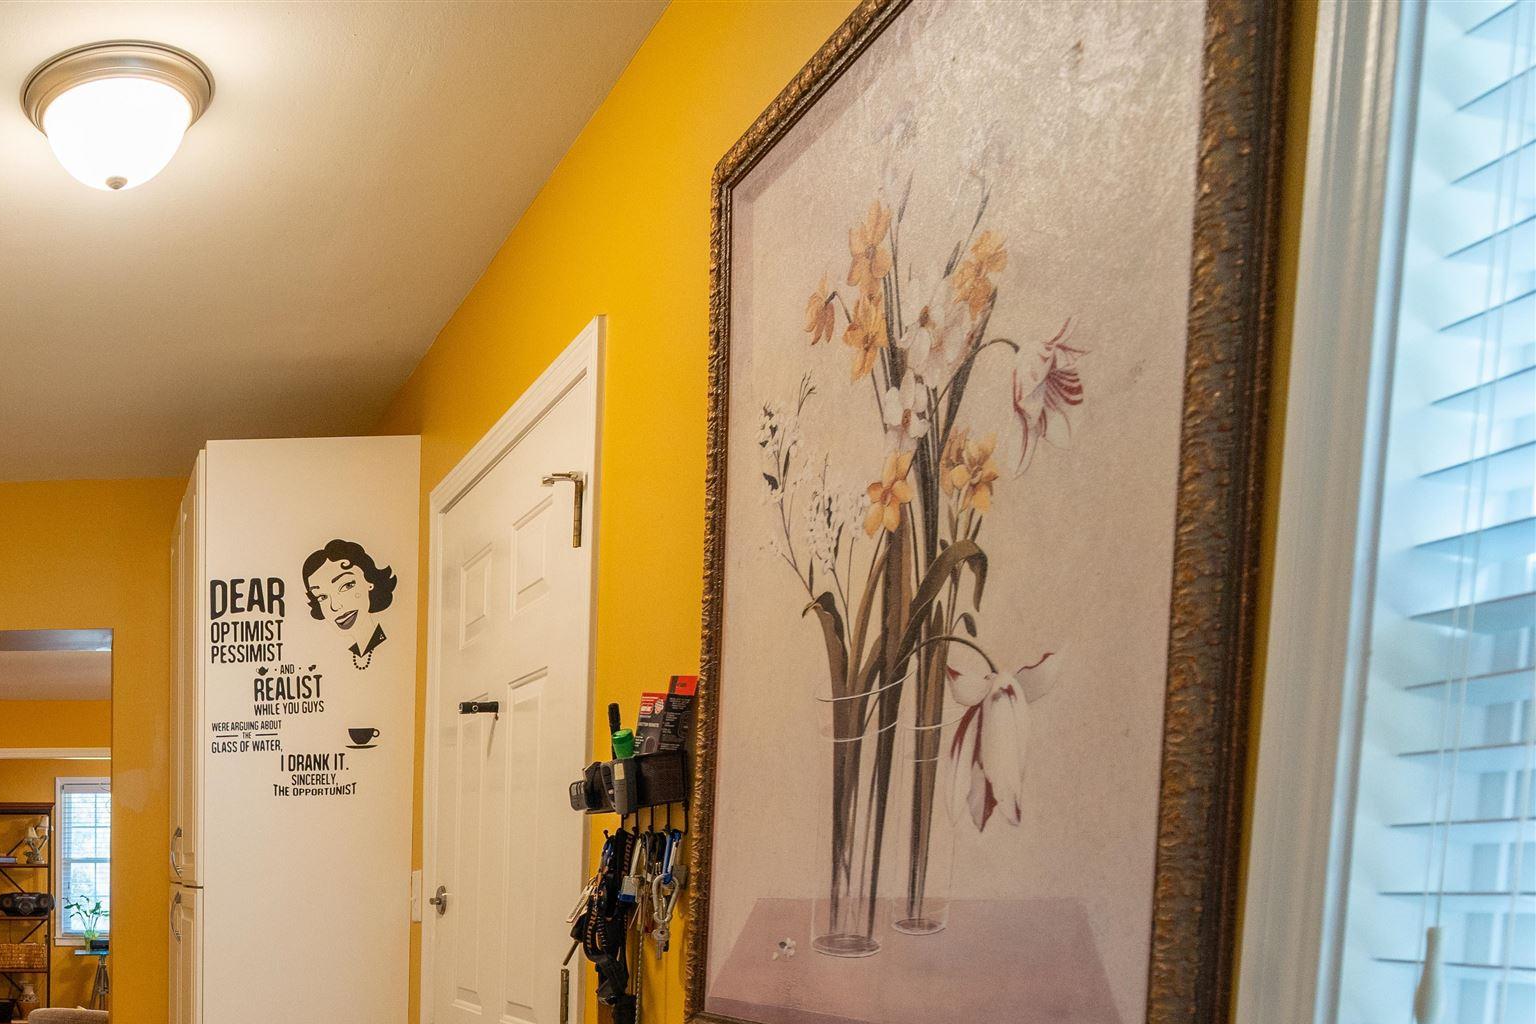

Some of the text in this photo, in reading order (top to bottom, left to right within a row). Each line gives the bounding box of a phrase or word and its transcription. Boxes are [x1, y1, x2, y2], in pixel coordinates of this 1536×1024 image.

[209, 577, 285, 620] DEAR
[210, 619, 284, 644] OPTIMIST
[211, 642, 283, 664] PESSIMIST
[280, 664, 295, 675] AND
[254, 674, 323, 702] REALIST
[254, 700, 325, 716] WHILE YOU GUYS
[211, 719, 282, 732] WERE ARGUING ABOUT
[242, 731, 252, 740] THE
[211, 741, 238, 754] GLASS
[239, 740, 250, 752] OF
[280, 752, 349, 772] I DRANK IT.
[291, 773, 339, 786] SINCERELY,
[273, 782, 357, 797] THE OPPORTUNIST
